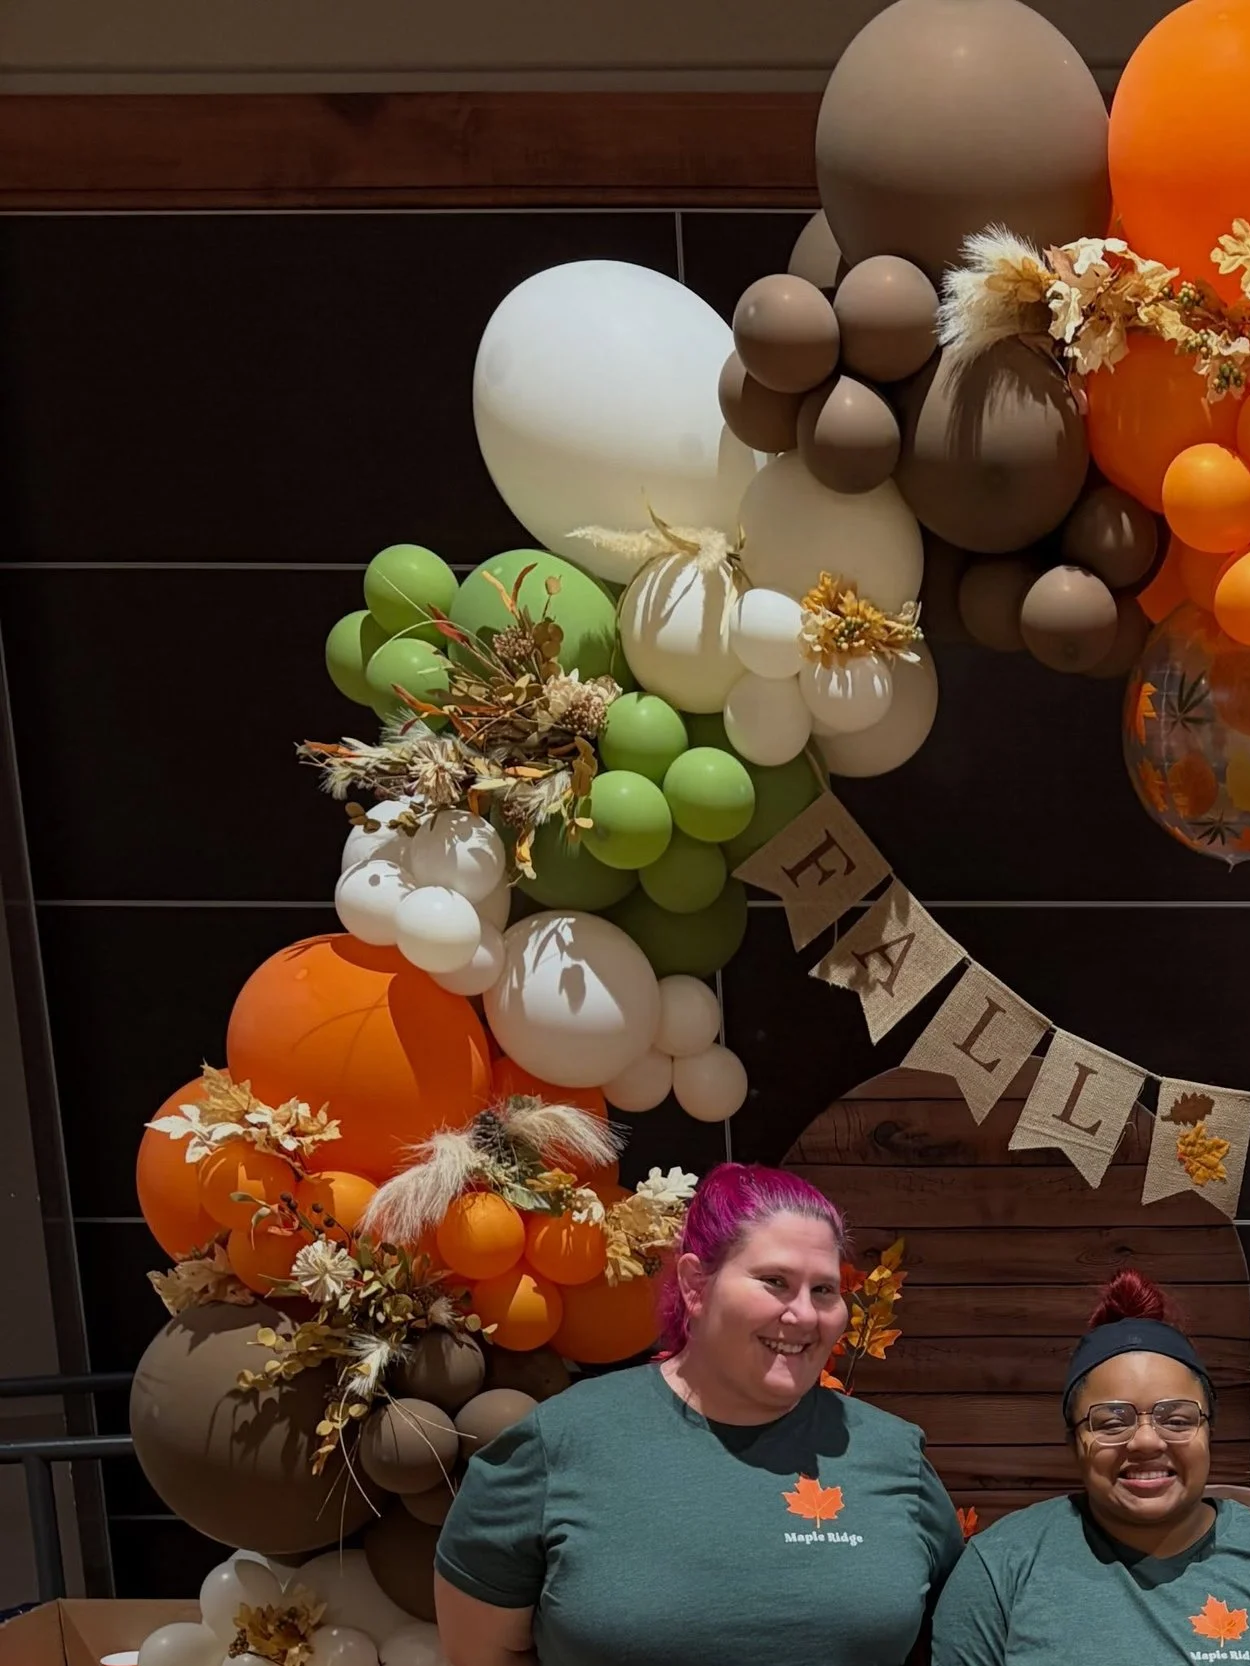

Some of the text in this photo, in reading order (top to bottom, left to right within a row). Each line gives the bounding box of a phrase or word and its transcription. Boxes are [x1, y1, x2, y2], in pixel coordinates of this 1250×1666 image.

[780, 828, 1107, 1137] FALL
[784, 1531, 864, 1547] Maple Ridge
[1190, 1650, 1227, 1663] Maple
